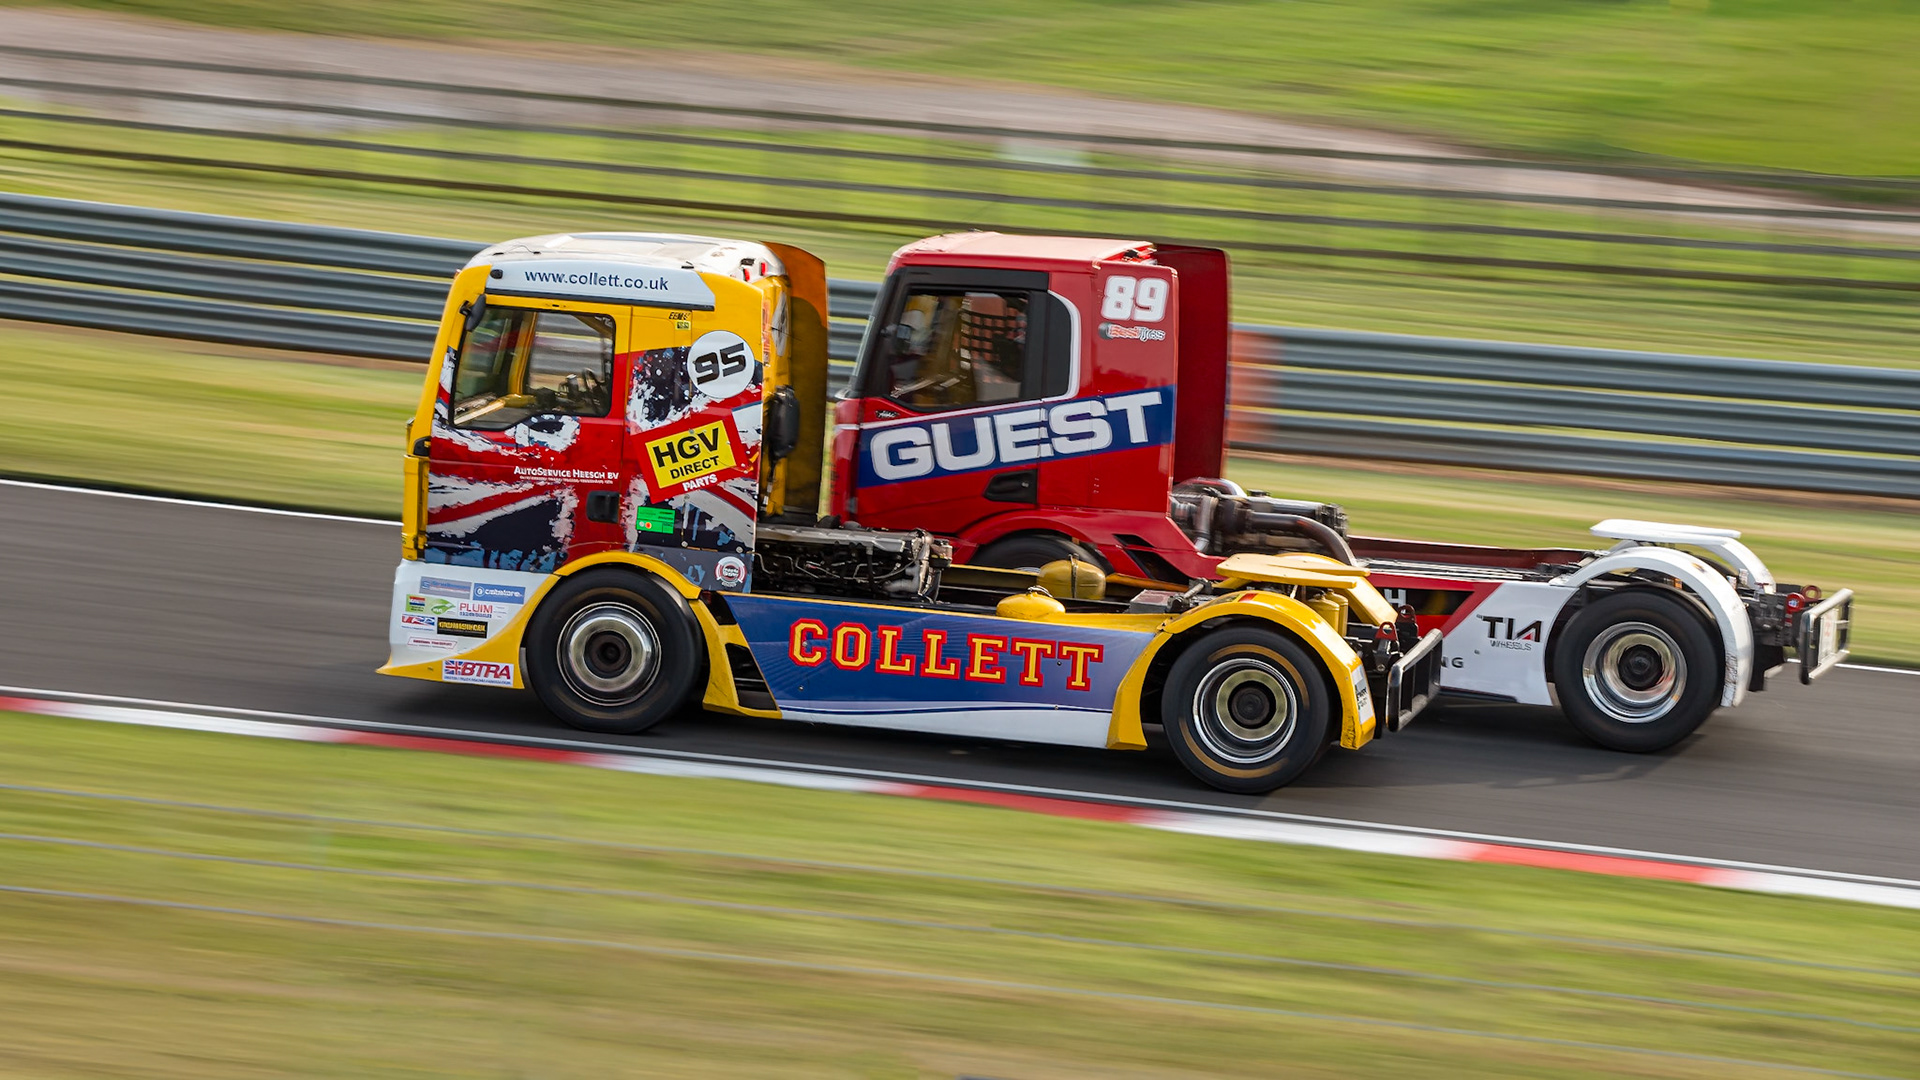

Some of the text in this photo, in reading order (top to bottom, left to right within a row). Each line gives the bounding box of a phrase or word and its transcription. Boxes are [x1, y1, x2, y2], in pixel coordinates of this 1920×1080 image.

[525, 271, 669, 291] www.collett.co.uk
[1101, 275, 1169, 322] 89
[693, 342, 746, 385] 95
[652, 427, 719, 468] HGV
[870, 391, 1162, 480] GUEST
[669, 455, 719, 479] DIRECT
[682, 474, 718, 491] PARTS
[459, 602, 493, 614] PLUIM
[1481, 615, 1542, 643] TIA
[788, 618, 1104, 692] COLLETT
[1490, 640, 1532, 651] WHEELS
[461, 662, 511, 680] BTRA
